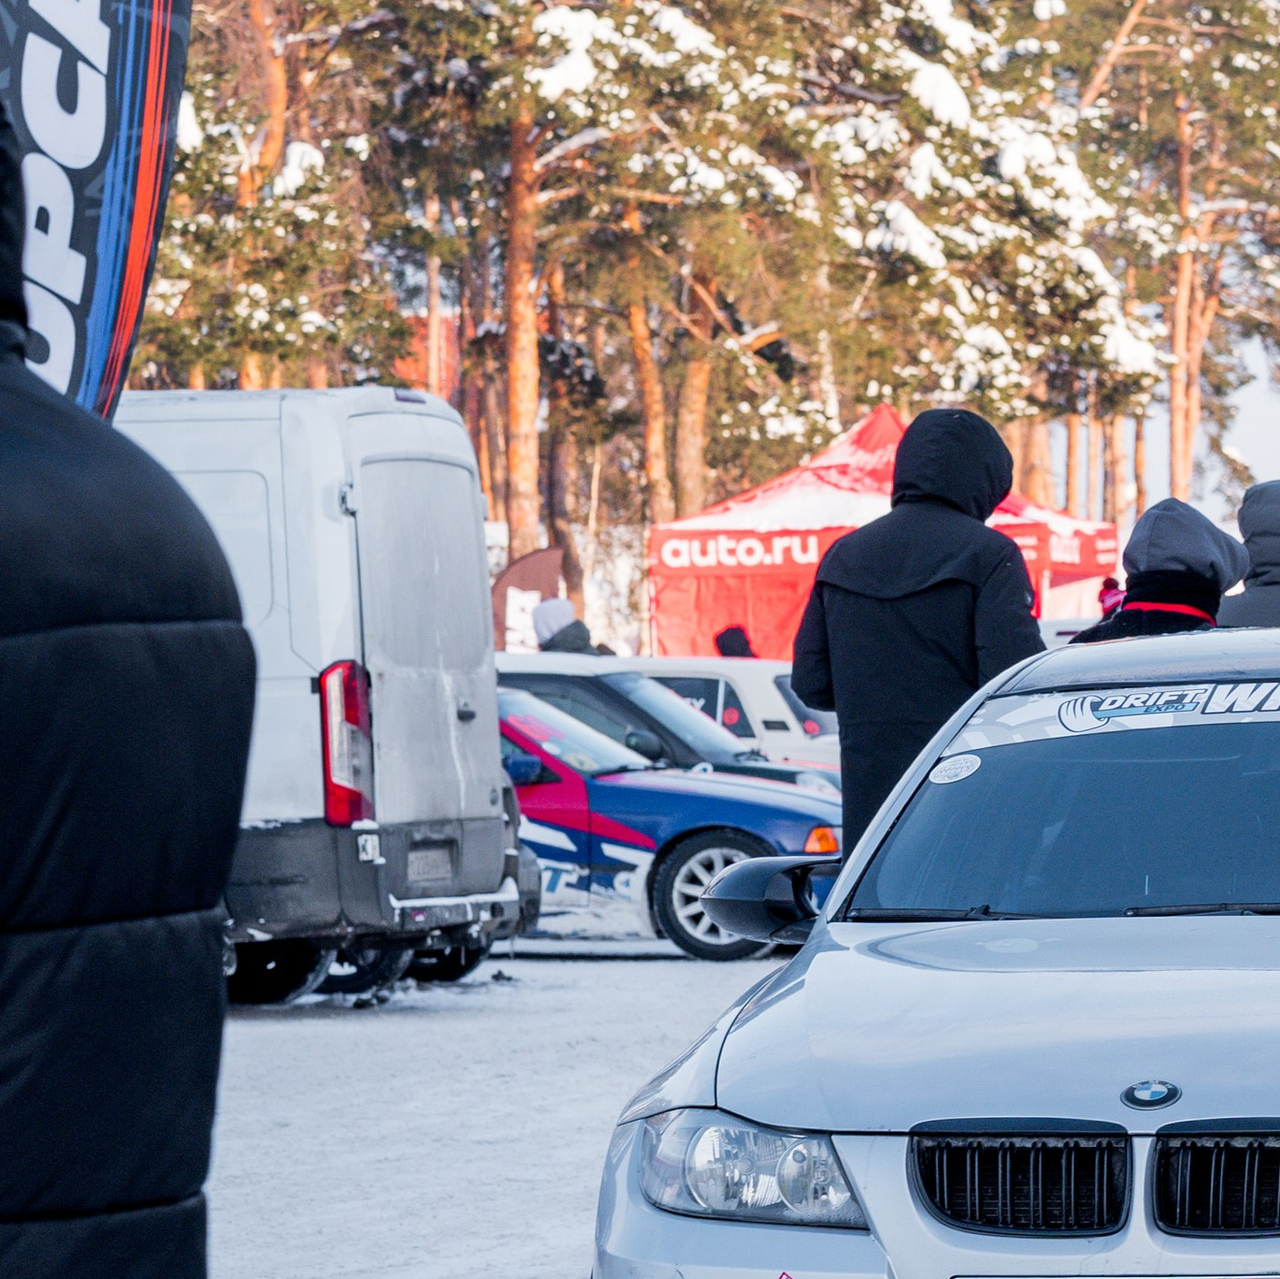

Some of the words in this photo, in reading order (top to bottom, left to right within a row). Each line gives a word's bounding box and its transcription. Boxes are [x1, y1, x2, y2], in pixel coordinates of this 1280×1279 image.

[661, 534, 819, 568] auto.ru
[1098, 689, 1206, 710] DRIFT
[1143, 703, 1185, 713] EXPO
